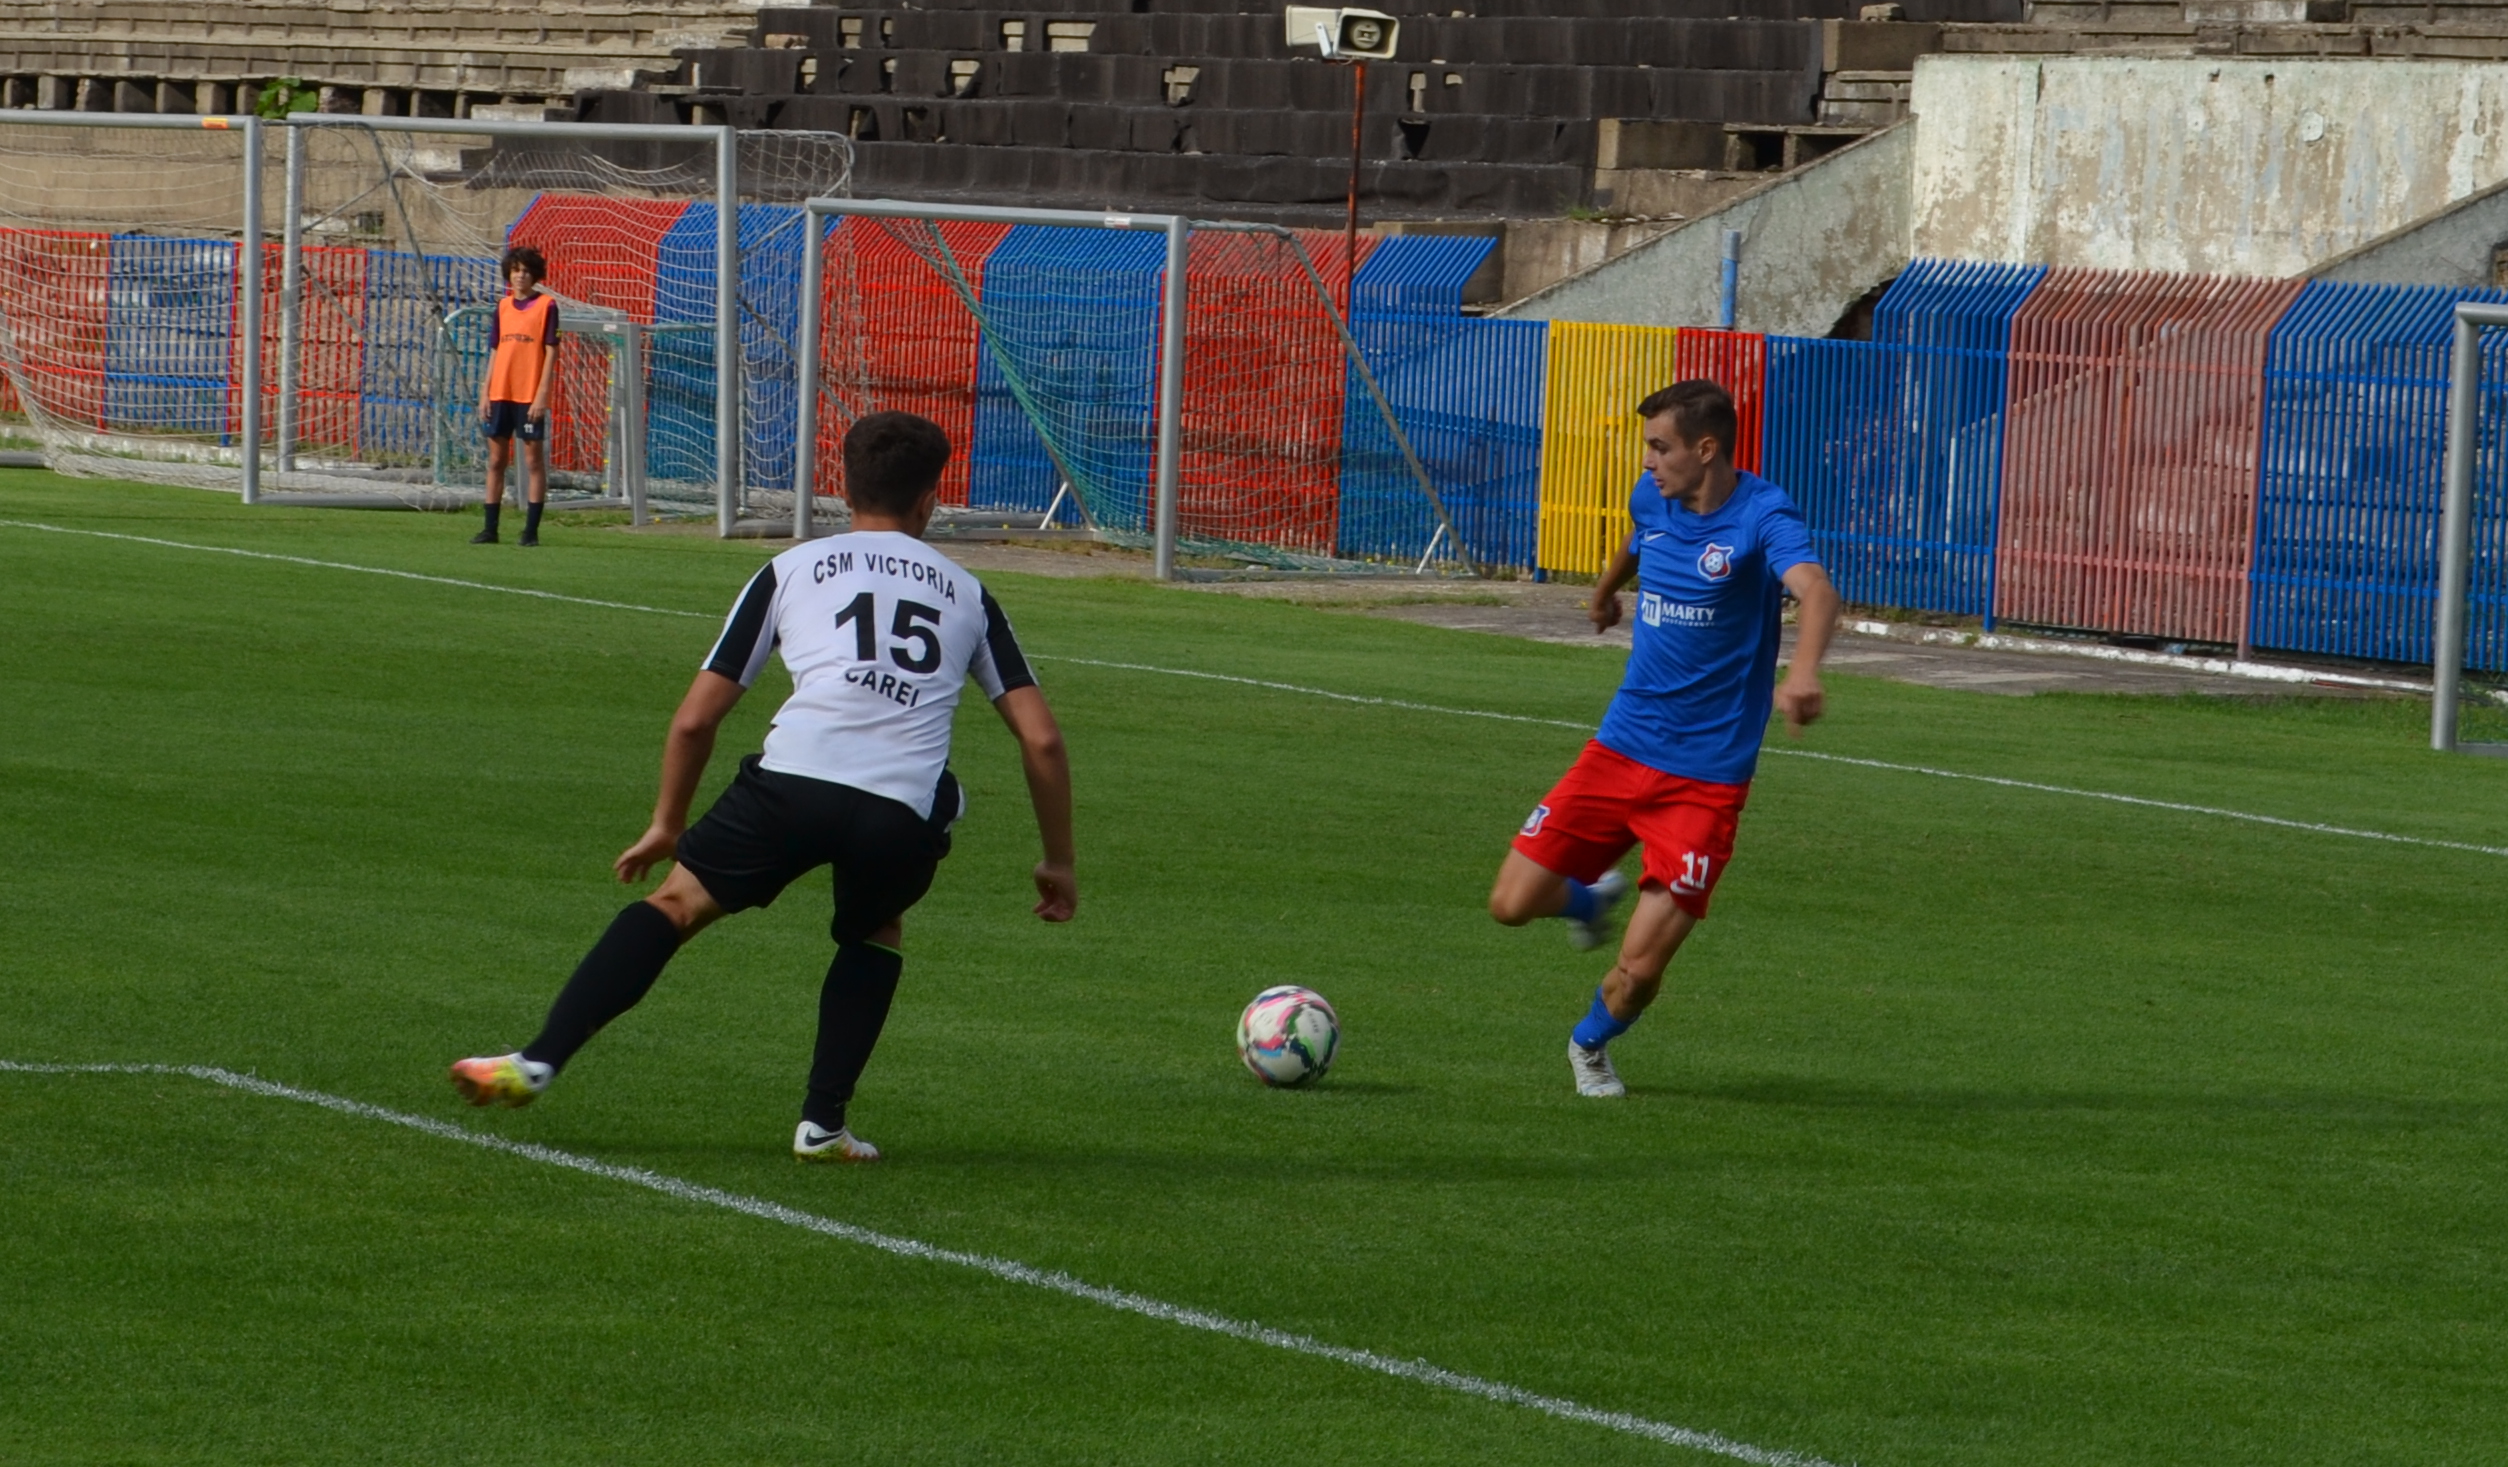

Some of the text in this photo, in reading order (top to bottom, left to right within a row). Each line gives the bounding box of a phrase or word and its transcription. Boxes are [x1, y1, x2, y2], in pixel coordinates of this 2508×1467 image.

[813, 552, 956, 604] CSM VICTORIA
[834, 591, 941, 674] 15
[1662, 602, 1715, 621] MARTY
[1681, 851, 1709, 890] 11
